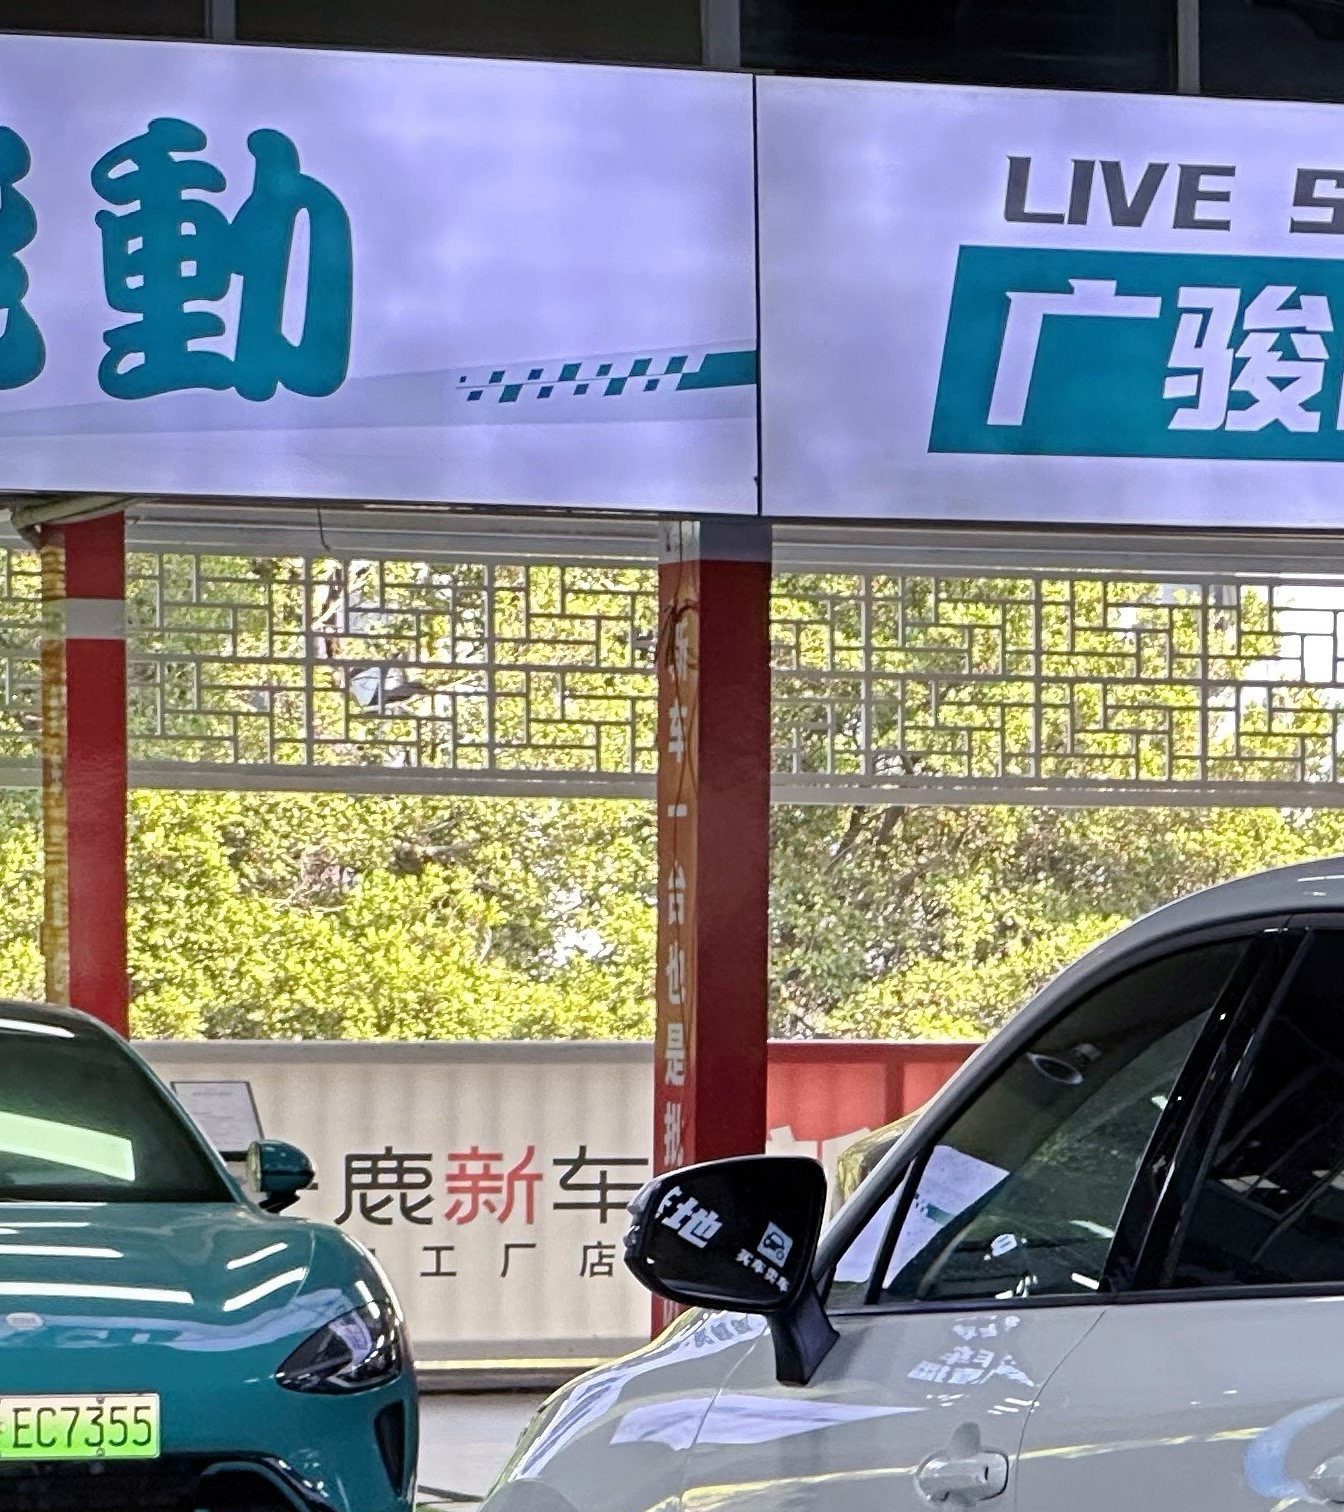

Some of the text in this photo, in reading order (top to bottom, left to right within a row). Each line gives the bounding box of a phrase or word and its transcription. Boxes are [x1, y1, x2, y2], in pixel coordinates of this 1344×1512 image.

[1003, 155, 1236, 231] LIVE
[299, 1145, 649, 1225] 鹿新车
[369, 1241, 616, 1278] 工厂店
[13, 1406, 151, 1449] EC7355
